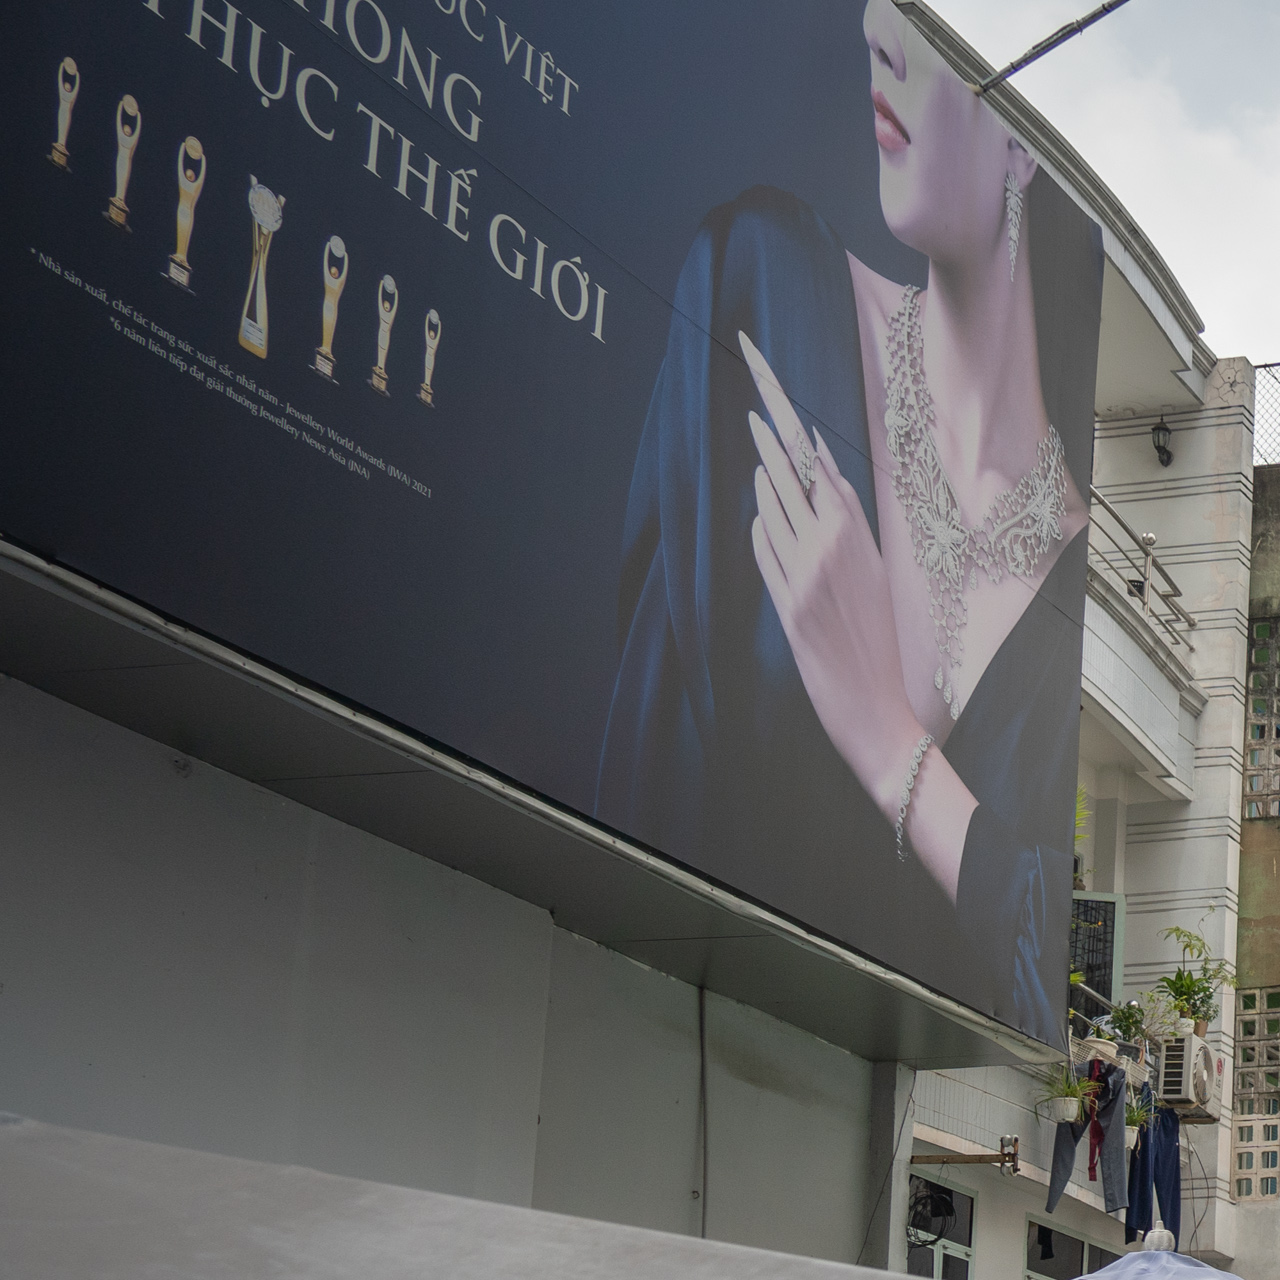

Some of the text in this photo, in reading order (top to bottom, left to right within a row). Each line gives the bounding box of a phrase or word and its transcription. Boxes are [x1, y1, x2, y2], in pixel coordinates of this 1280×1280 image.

[495, 15, 580, 117] VIỆT
[142, 0, 608, 344] HỤC THẾ GIỚI
[38, 252, 62, 276] Nhà
[63, 270, 82, 287] sản
[84, 282, 110, 306] xuất,
[112, 299, 134, 317] chế
[133, 310, 150, 328] tác
[151, 321, 177, 348] trang
[177, 340, 195, 356] sức
[196, 351, 218, 370] xuất
[218, 363, 235, 380] sắc
[235, 373, 257, 394] nhất
[258, 387, 279, 406] năm
[285, 402, 326, 436] Jewellery
[327, 426, 354, 452] World
[354, 445, 387, 471] Awards
[386, 464, 412, 487] (JWA)
[411, 478, 432, 499] 2021
[123, 328, 147, 347] năm
[148, 338, 167, 360] liên
[168, 353, 188, 373] tiếp
[189, 365, 206, 382] đạt
[206, 377, 224, 392] giải
[225, 386, 259, 416] thưởng
[258, 405, 301, 440] Jewellery
[301, 431, 327, 454] News
[328, 448, 347, 466] Asia
[347, 459, 371, 480] (JNA)
